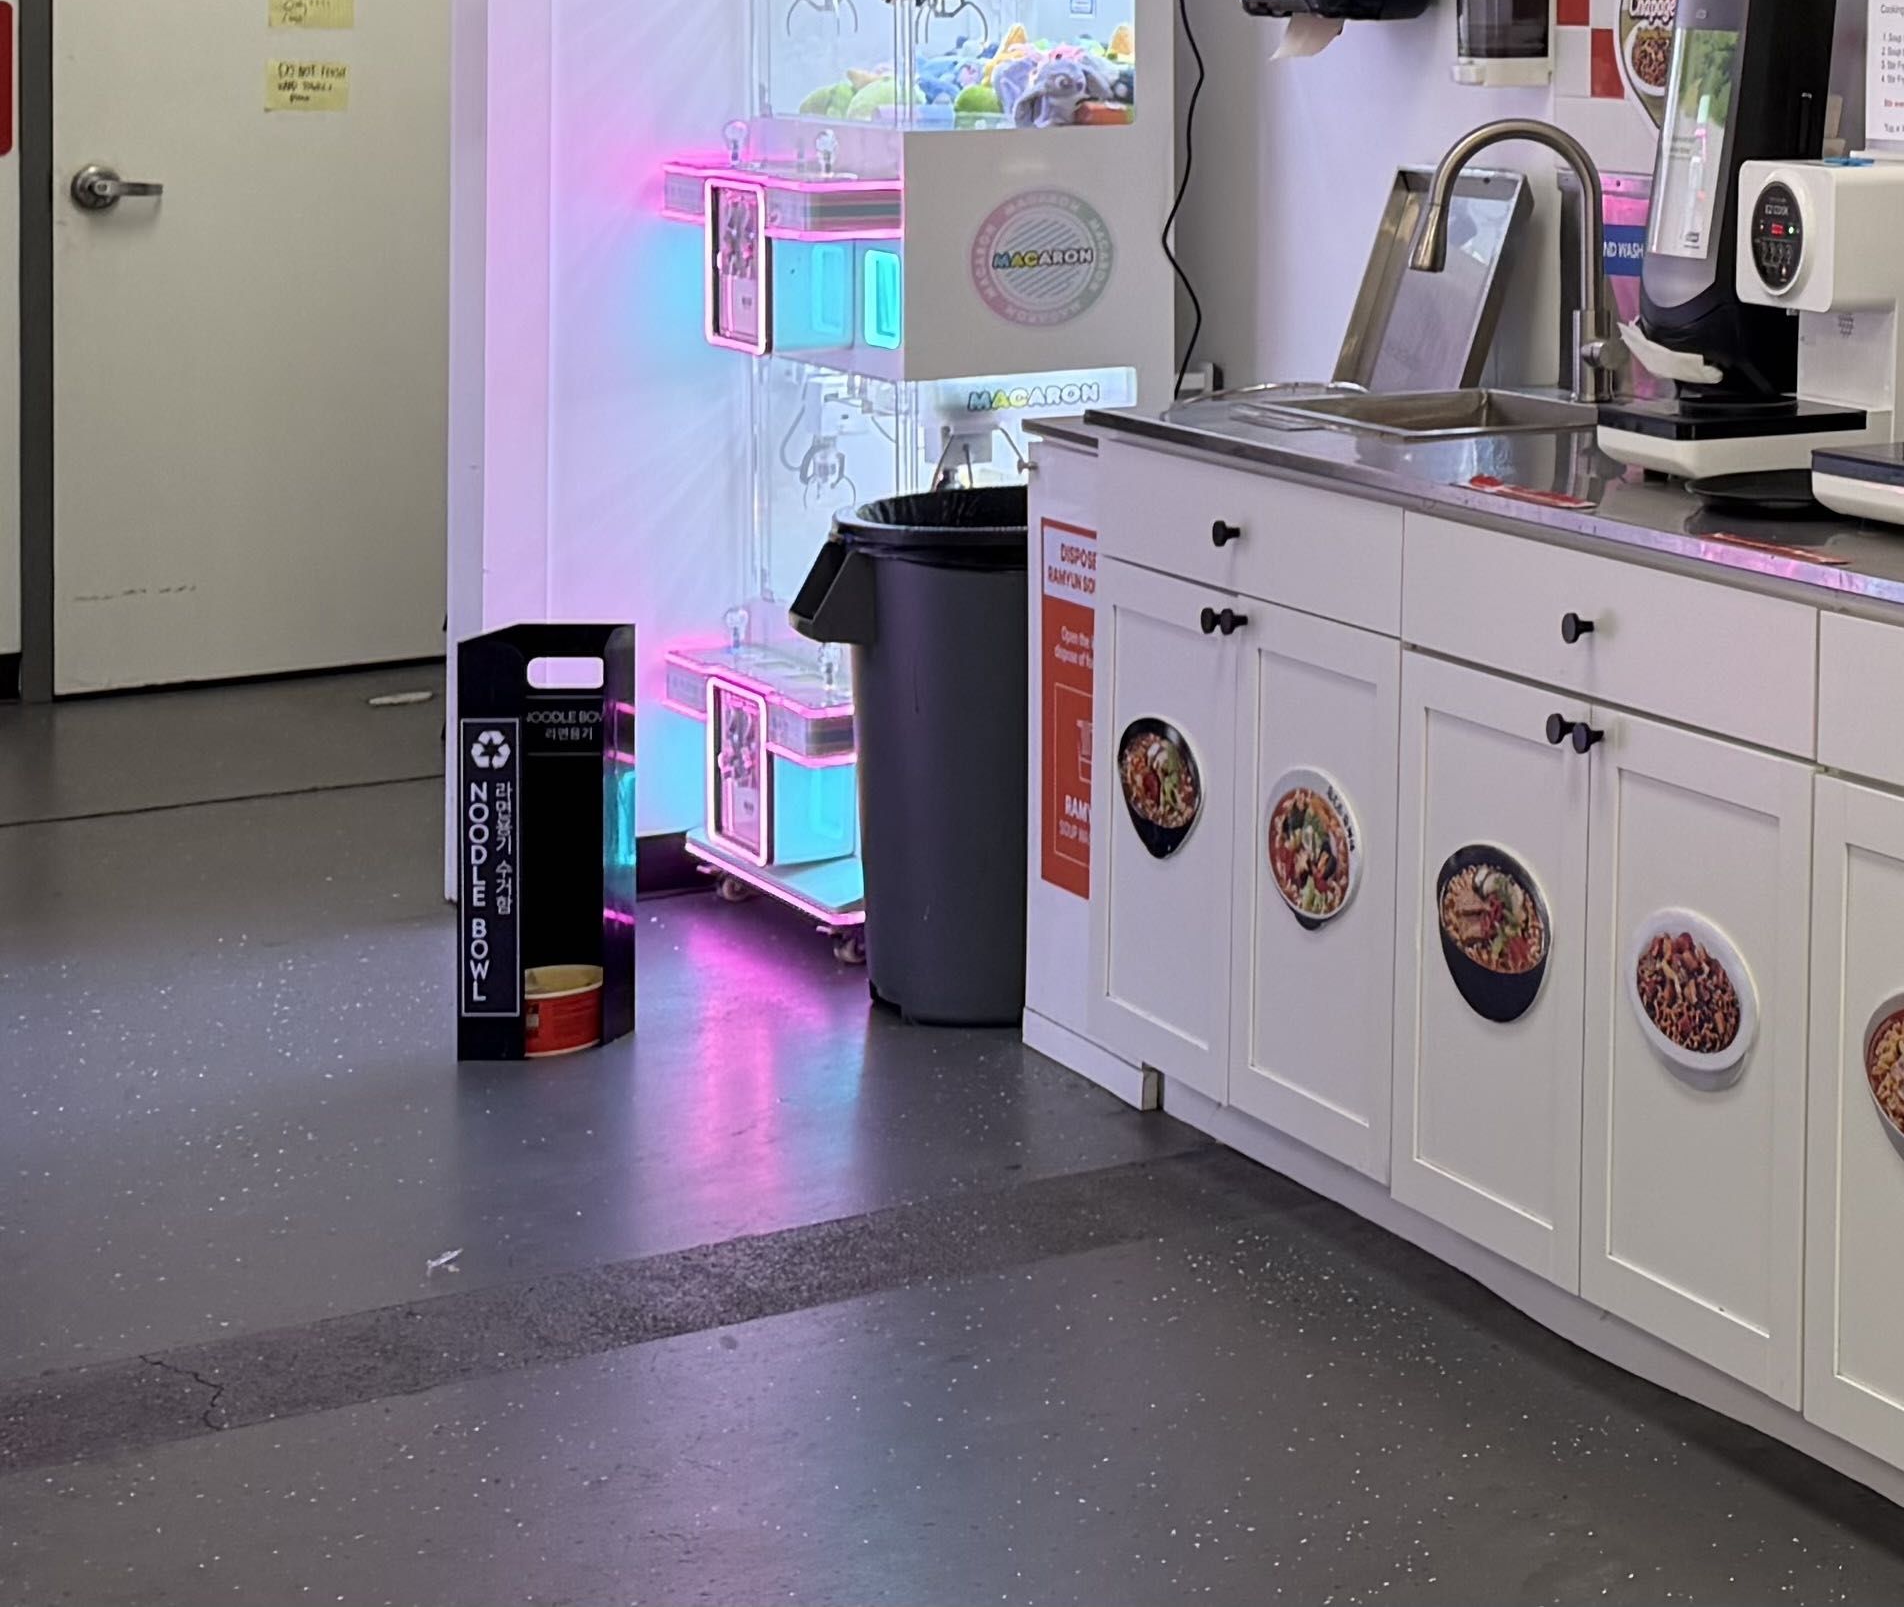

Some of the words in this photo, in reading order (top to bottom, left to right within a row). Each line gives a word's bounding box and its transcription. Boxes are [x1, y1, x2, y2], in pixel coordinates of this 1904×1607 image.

[992, 248, 1093, 268] MACARON
[968, 382, 1099, 411] MACARON
[469, 782, 489, 907] NOODLE
[469, 919, 489, 1001] BOWL
